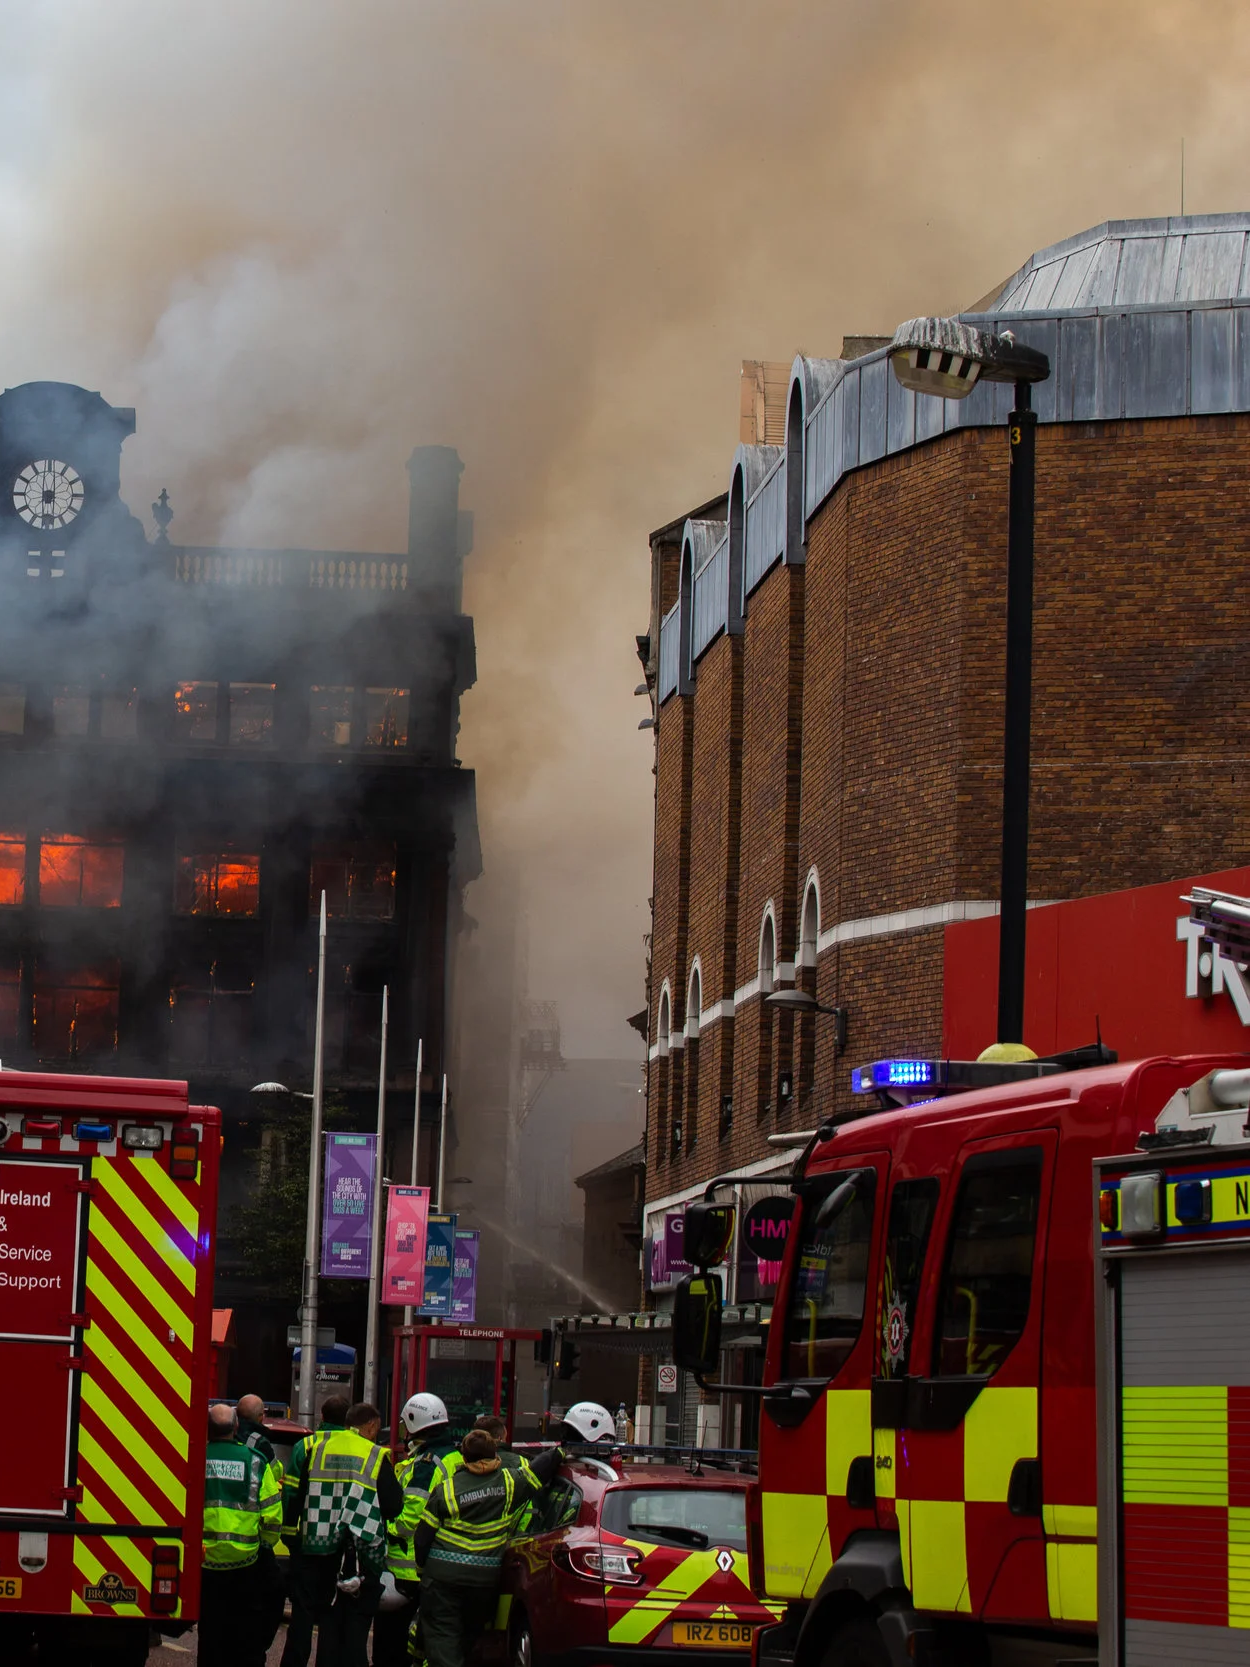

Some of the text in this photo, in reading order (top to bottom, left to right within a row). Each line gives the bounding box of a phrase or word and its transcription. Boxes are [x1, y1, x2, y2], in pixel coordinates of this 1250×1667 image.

[1011, 426, 1021, 445] 3
[0, 1189, 51, 1207] Ireland
[458, 1328, 504, 1338] TELEPHONE
[459, 1486, 506, 1505] AMBULANCE
[87, 1588, 135, 1602] BROWNS
[686, 1624, 752, 1642] IRZ 608
